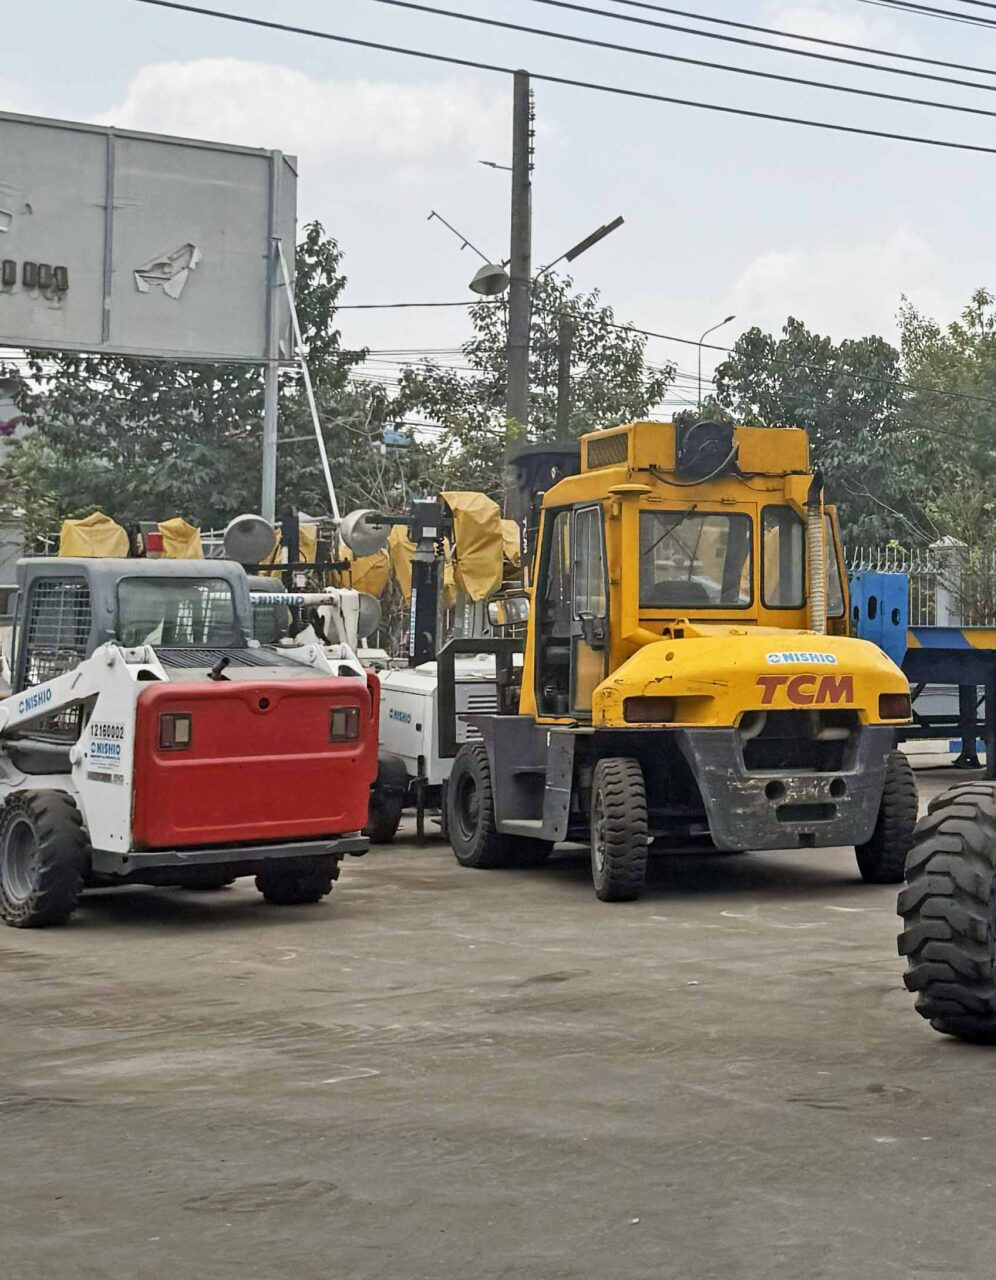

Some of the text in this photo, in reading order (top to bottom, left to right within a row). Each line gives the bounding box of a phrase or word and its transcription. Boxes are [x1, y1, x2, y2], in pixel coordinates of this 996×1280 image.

[258, 595, 305, 605] NISHIO
[782, 653, 836, 663] NISHIO
[756, 675, 854, 705] TCM
[25, 688, 52, 711] NISHIO
[91, 724, 124, 739] 12160002
[96, 742, 121, 755] NISHIO
